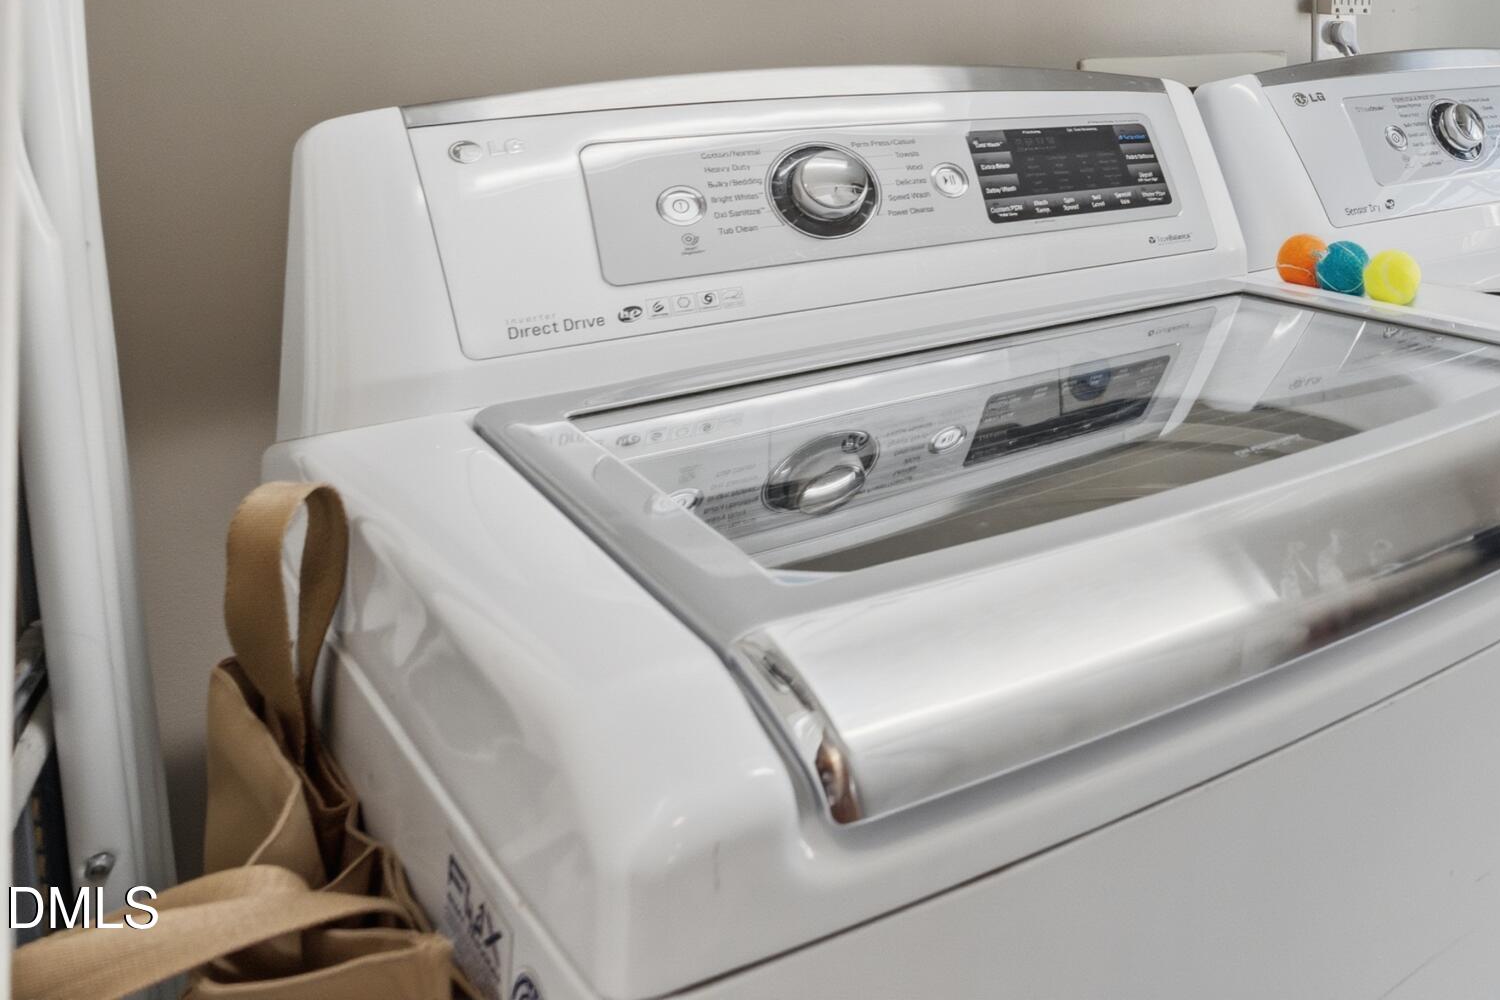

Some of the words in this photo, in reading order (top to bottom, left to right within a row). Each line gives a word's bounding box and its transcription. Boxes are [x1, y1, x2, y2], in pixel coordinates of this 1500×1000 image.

[1308, 91, 1326, 103] LG
[486, 137, 526, 157] LG
[731, 164, 751, 172] Duty
[735, 224, 760, 234] Clean
[507, 320, 560, 341] Direct
[563, 315, 606, 332] Drive
